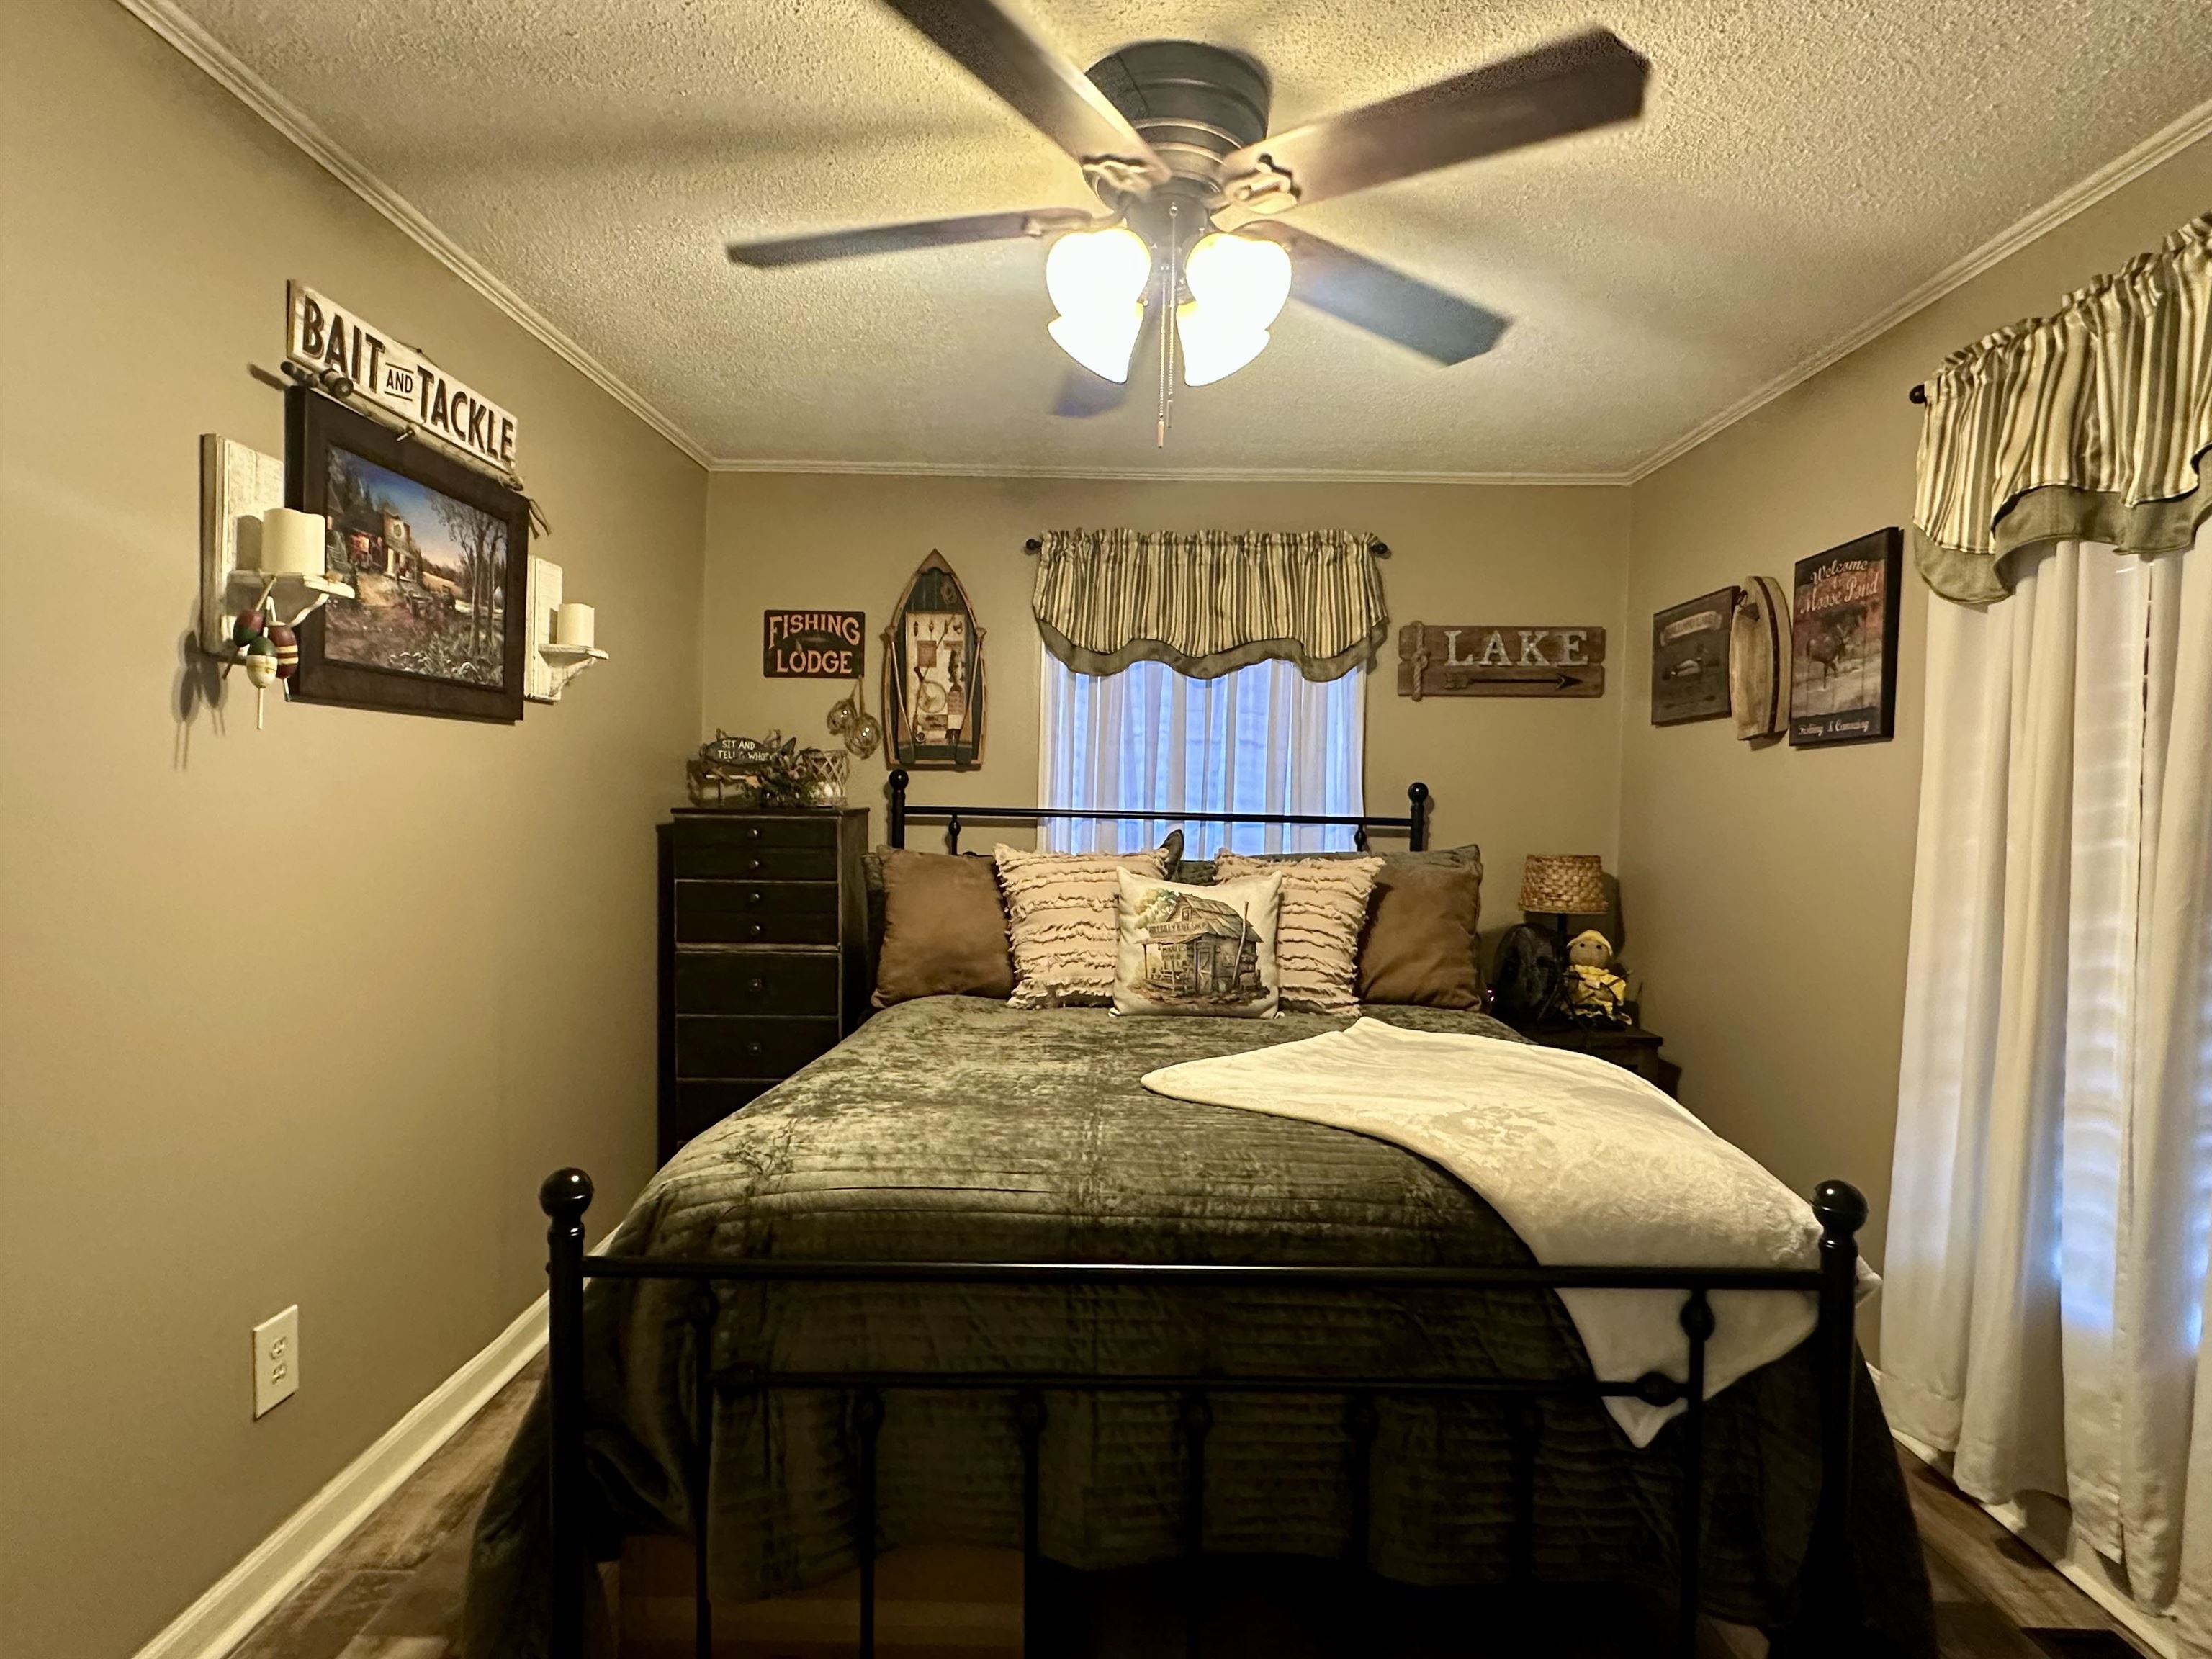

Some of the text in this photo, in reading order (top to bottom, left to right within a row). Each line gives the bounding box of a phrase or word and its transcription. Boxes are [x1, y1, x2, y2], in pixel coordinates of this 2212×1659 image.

[302, 295, 515, 462] BAIT AND TACKLE
[1810, 559, 1868, 585] Welcome
[1844, 571, 1879, 602] Pond
[768, 613, 861, 649] FISHING
[777, 649, 853, 674] LODGE
[1444, 629, 1588, 667] LAKE
[721, 739, 756, 750] SIT AND
